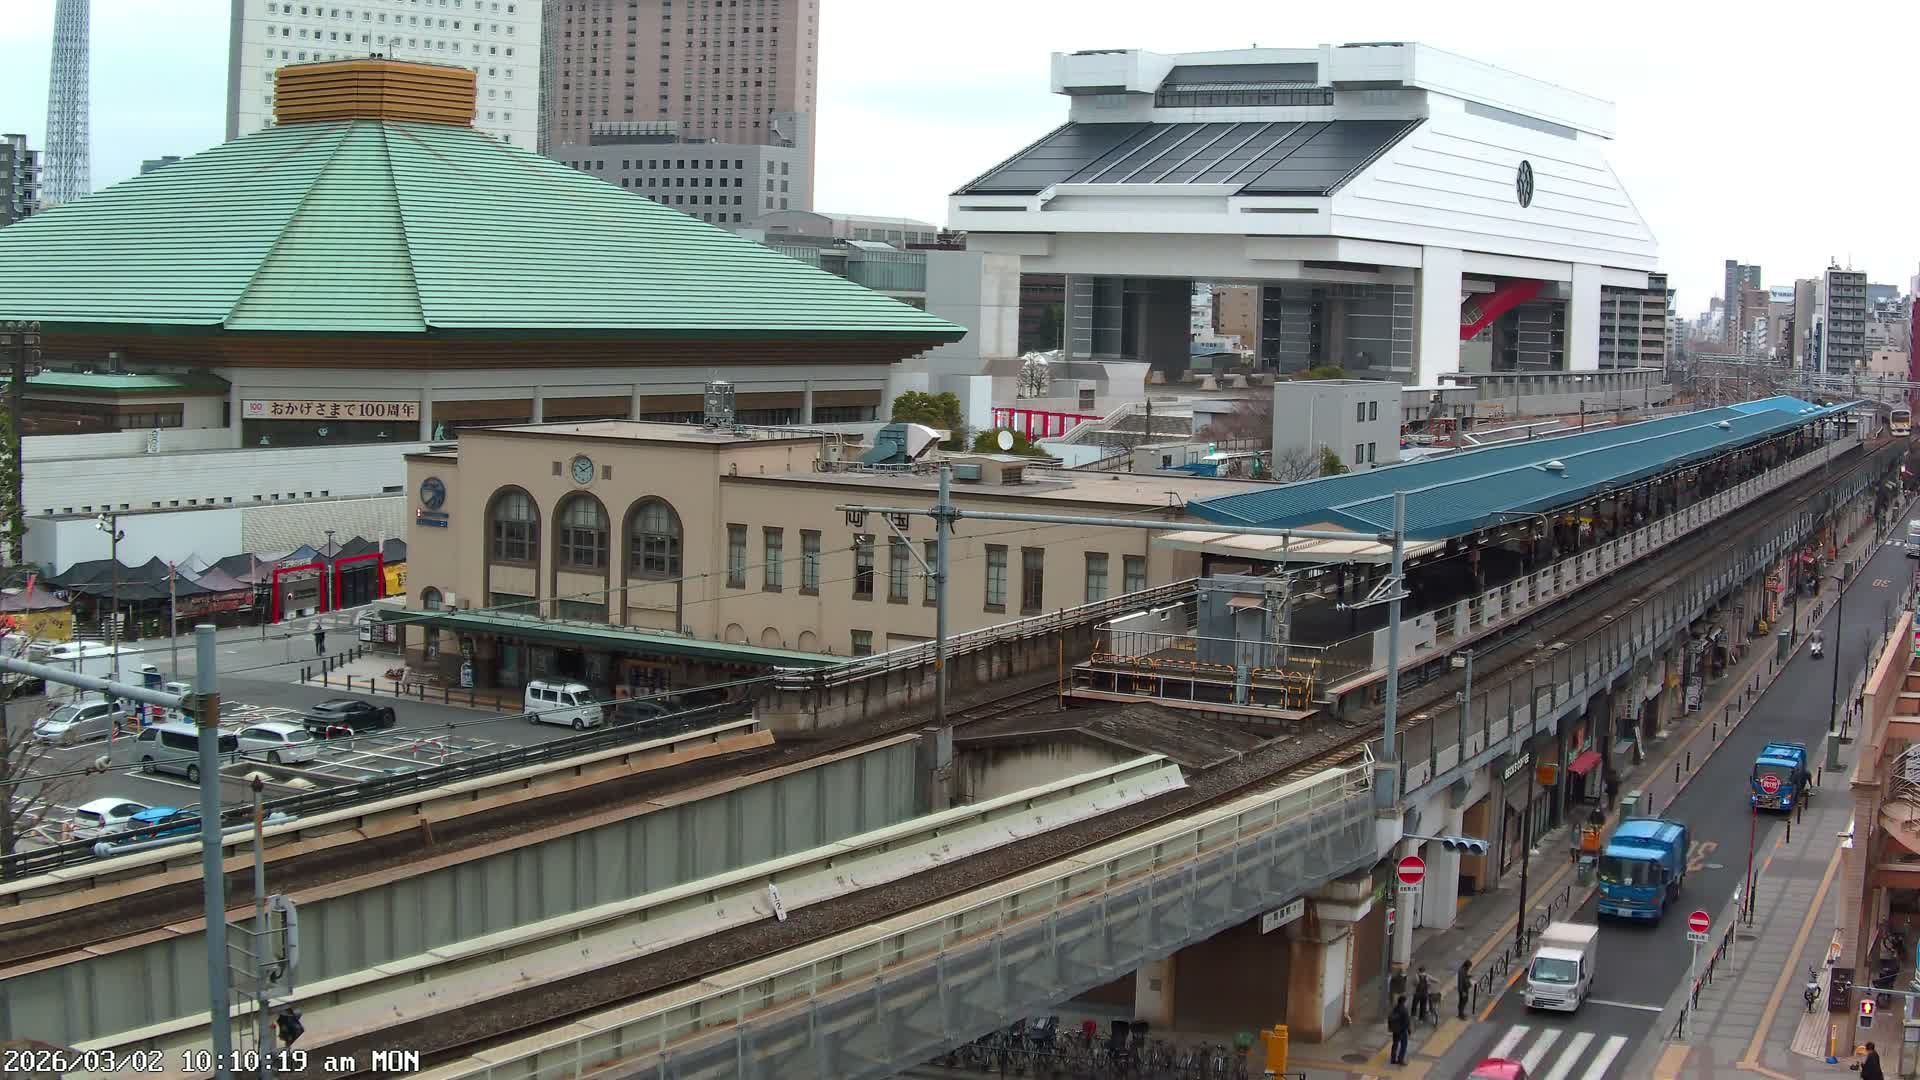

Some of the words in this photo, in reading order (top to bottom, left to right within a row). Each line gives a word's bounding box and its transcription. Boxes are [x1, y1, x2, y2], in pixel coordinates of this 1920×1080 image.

[271, 402, 415, 417] おかげさまで100周年
